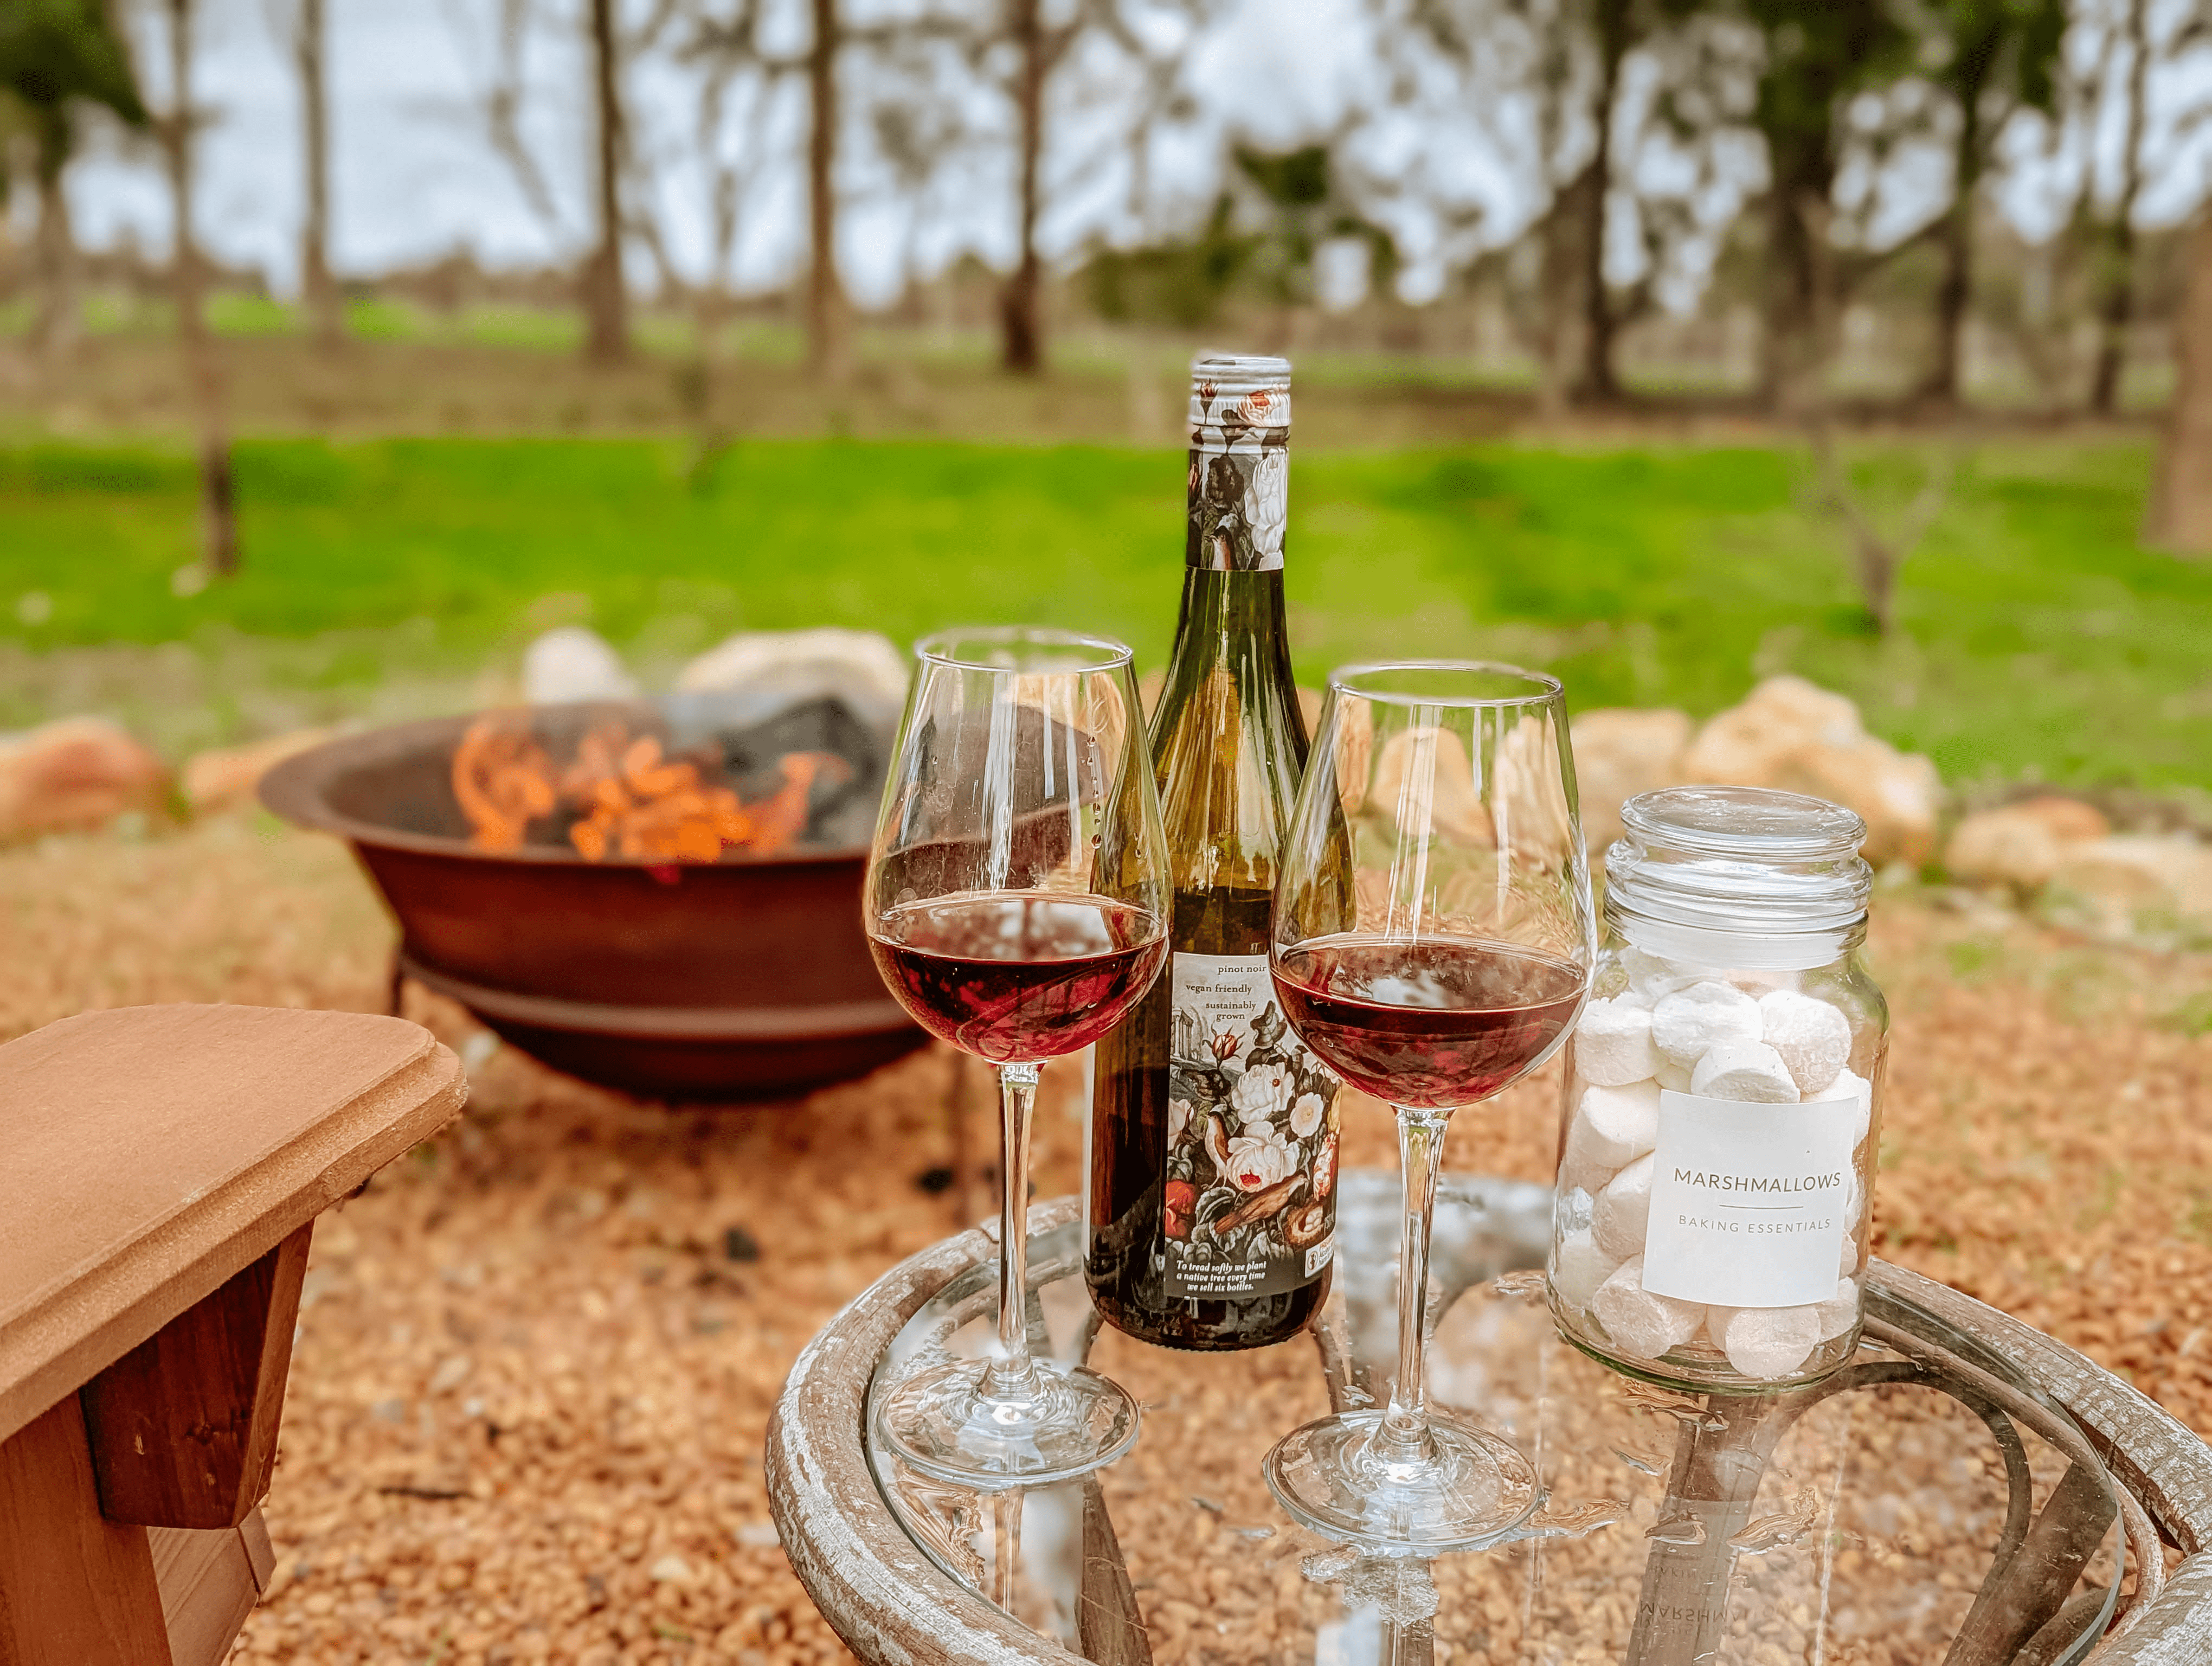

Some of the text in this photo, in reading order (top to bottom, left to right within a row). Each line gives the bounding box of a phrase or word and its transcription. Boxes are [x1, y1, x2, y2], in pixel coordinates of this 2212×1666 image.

[1217, 965, 1243, 975] pinot
[1186, 984, 1252, 995] vegan friendly
[1206, 1001, 1256, 1011] sustainably
[1674, 1168, 1840, 1192] MARSHMALLOWS
[1679, 1215, 1830, 1233] BAKING ESSENTIALS
[1176, 1260, 1187, 1270] To
[1189, 1263, 1211, 1272] tread
[1211, 1263, 1233, 1274] softly
[1246, 1261, 1266, 1273] plant
[1184, 1273, 1208, 1281] native
[1210, 1274, 1225, 1282] tree
[1227, 1274, 1247, 1283] every
[1249, 1272, 1265, 1280] time
[1200, 1282, 1213, 1291] sell
[1227, 1282, 1253, 1291] bottles.
